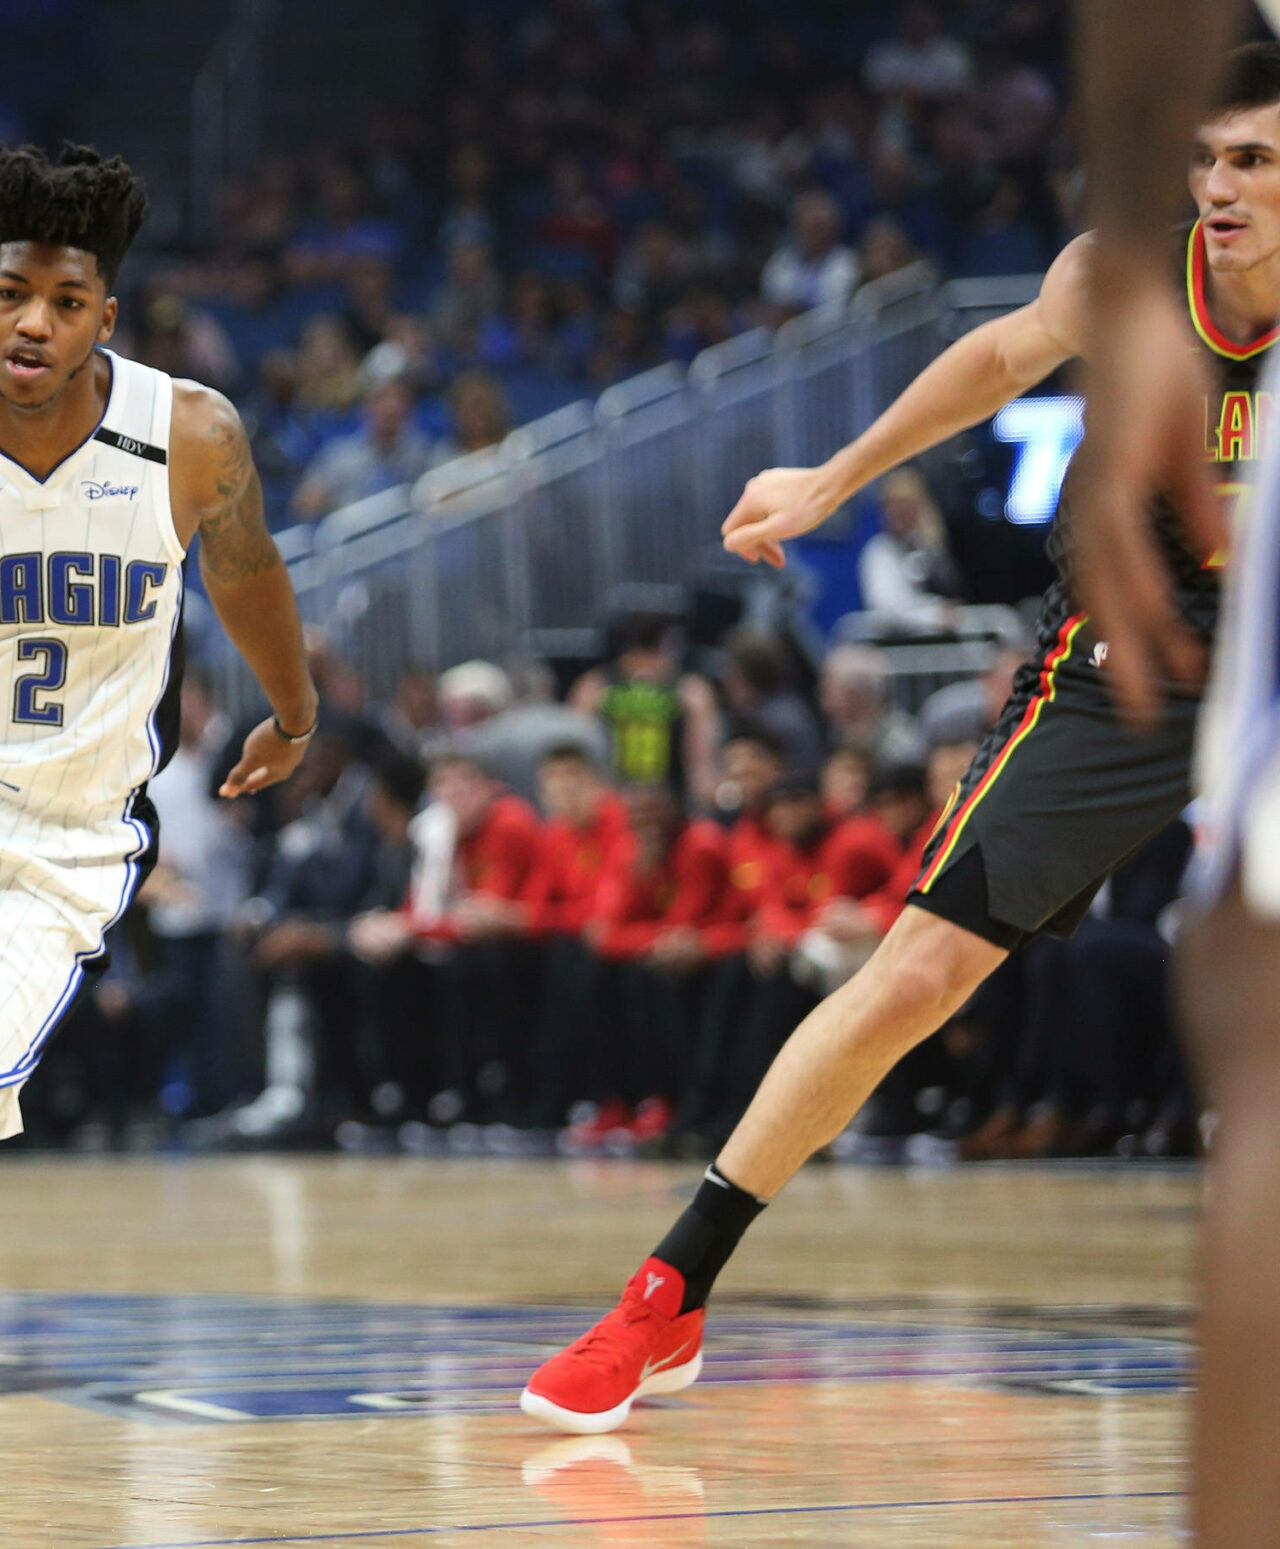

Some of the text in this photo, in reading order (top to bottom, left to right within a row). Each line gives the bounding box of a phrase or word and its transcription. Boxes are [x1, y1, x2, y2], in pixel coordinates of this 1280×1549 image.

[117, 435, 147, 455] HDV
[80, 481, 139, 501] Disney
[12, 637, 68, 727] 2
